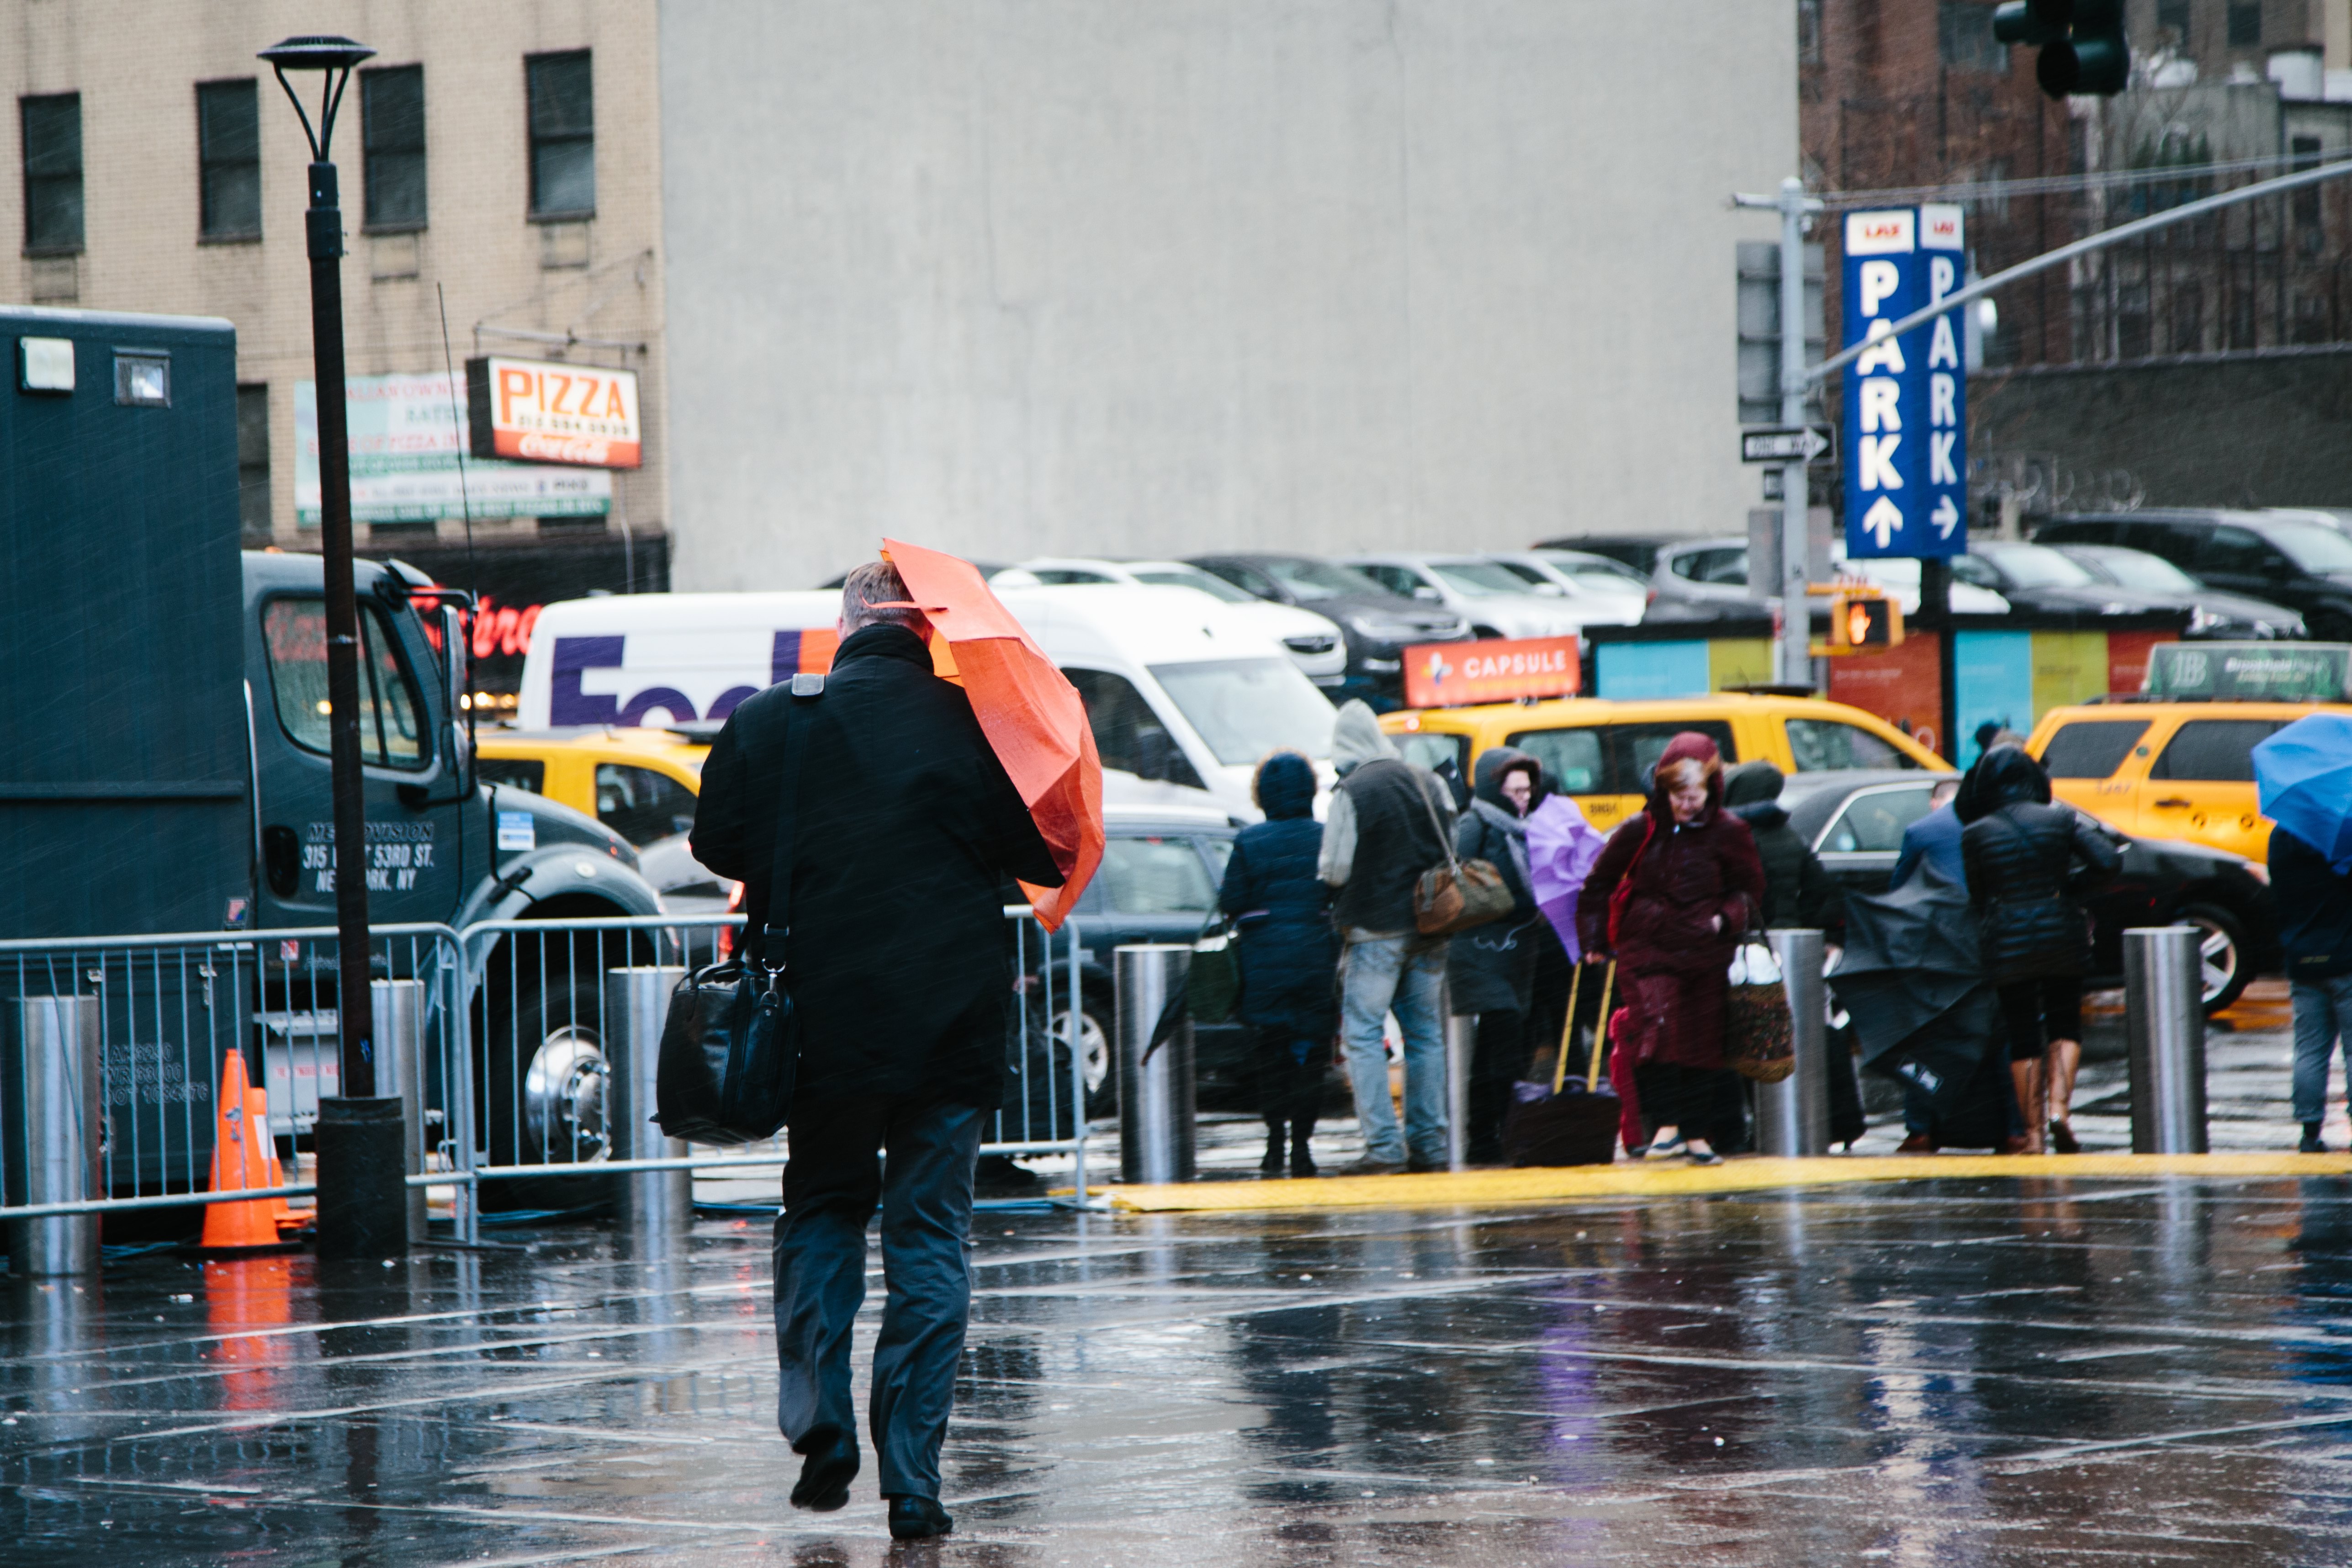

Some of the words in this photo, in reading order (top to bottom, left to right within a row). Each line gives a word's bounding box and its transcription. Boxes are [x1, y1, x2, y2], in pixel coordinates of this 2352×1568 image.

[1857, 260, 1906, 492] PARK
[1928, 256, 1959, 486] PARK
[499, 368, 626, 424] PIZZA
[1463, 650, 1566, 678] CAPSULE
[307, 823, 434, 842] MEVISION
[302, 844, 328, 869] 315
[373, 843, 411, 868] 53RD
[414, 843, 434, 868] ST.
[316, 869, 336, 892] NE
[396, 868, 417, 890] NY
